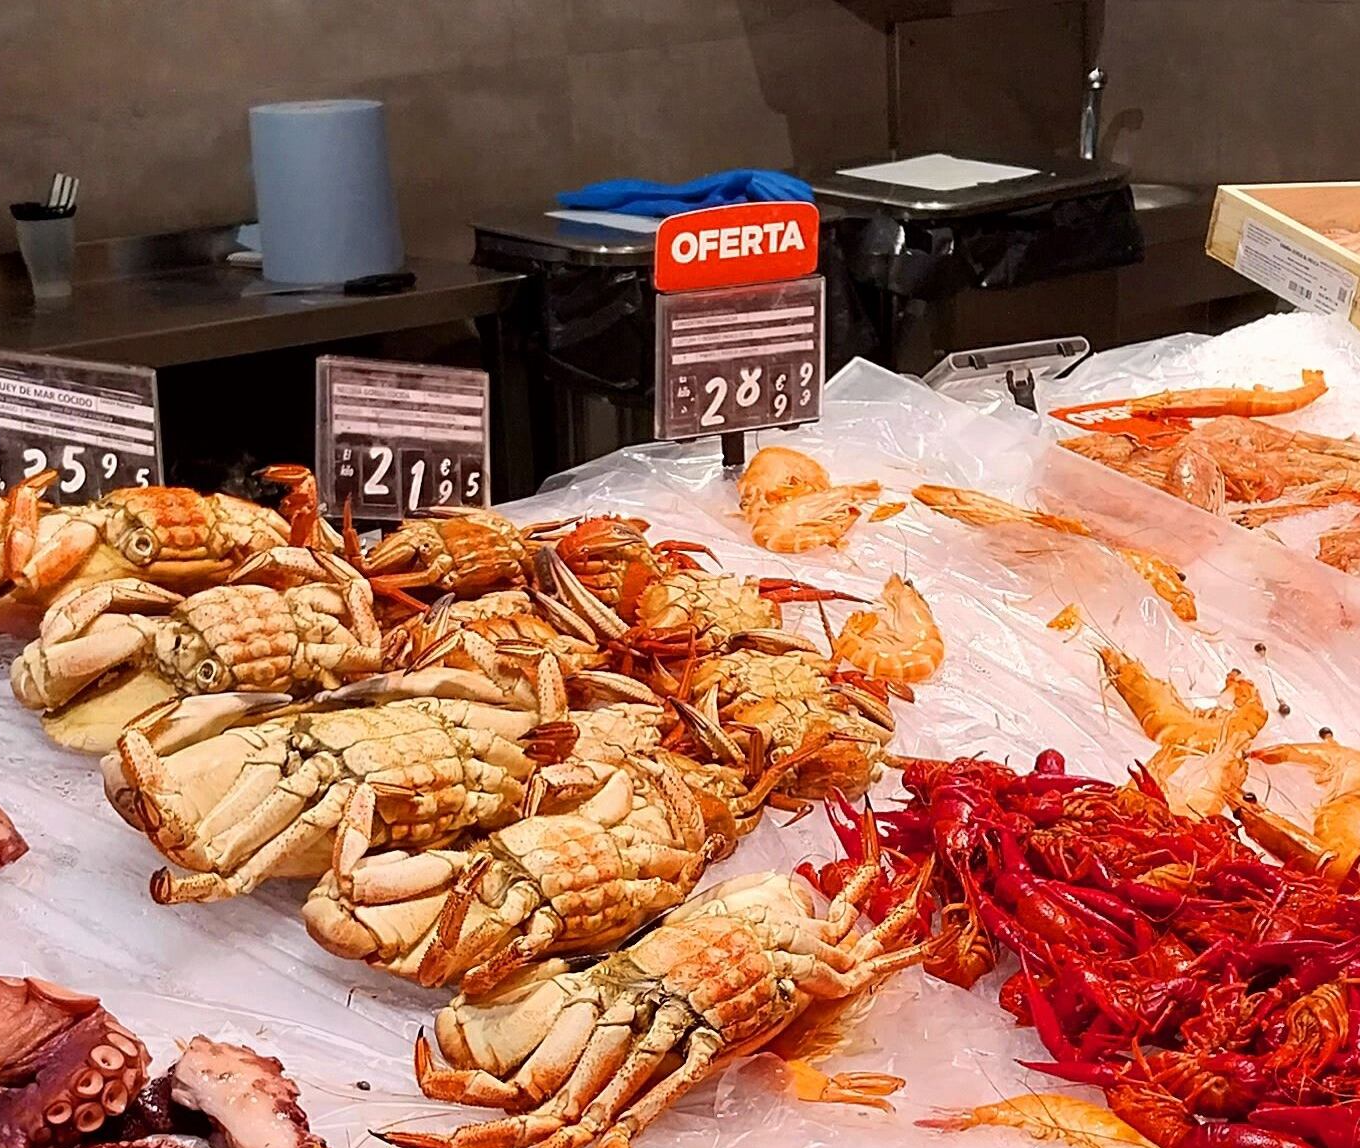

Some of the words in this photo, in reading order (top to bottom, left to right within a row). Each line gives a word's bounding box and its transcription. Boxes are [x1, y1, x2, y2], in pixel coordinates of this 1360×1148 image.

[671, 220, 805, 264] OFERTA
[19, 385, 32, 397] DE
[34, 388, 56, 400] MAR
[58, 393, 93, 408] COCIDO
[364, 446, 425, 511] 21
